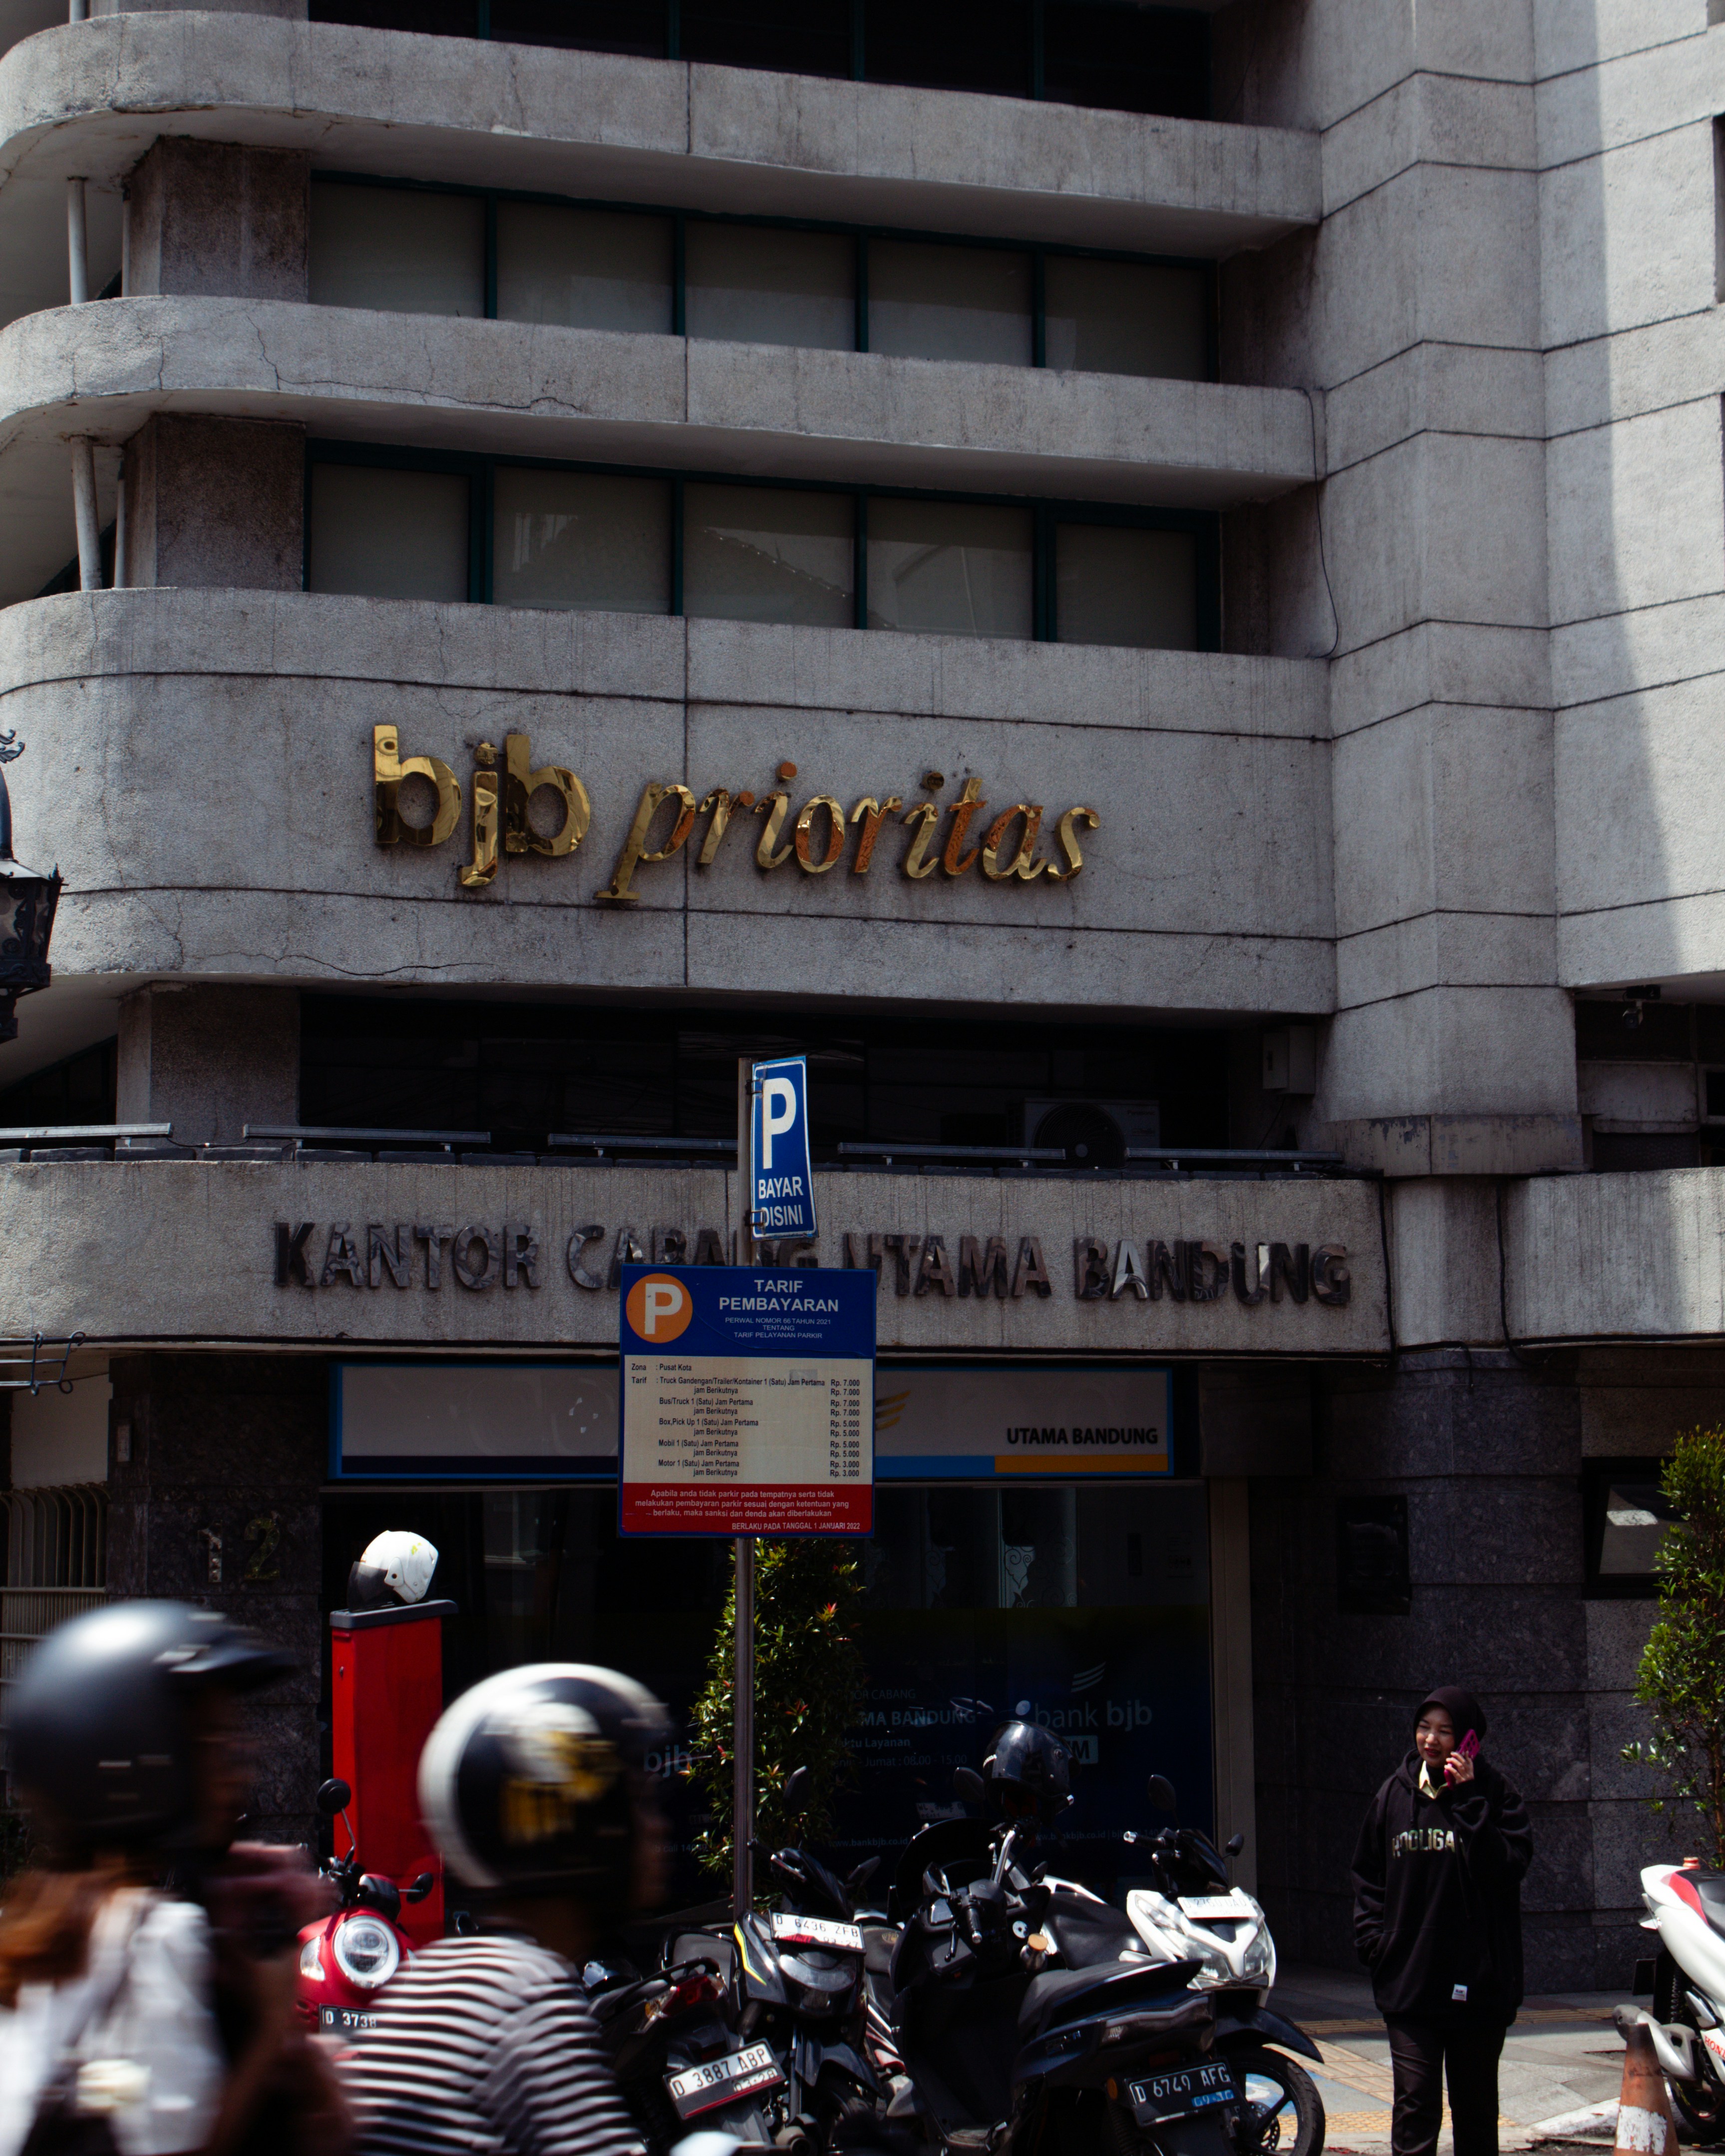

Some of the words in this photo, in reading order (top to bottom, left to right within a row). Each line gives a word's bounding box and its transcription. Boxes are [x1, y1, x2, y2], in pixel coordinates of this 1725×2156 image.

[373, 724, 591, 887] bjb
[595, 761, 1100, 899] prioritas
[763, 1077, 796, 1169] P
[758, 1176, 803, 1199] BAYAR
[761, 1205, 803, 1227] DISINI
[275, 1222, 541, 1289] KANTOR
[843, 1232, 1051, 1297] UTAMA
[1074, 1237, 1349, 1305] BANDUNG
[754, 1279, 803, 1293] TARIF
[645, 1283, 683, 1335] P
[719, 1297, 838, 1312] PEMBAYARAN
[679, 1377, 762, 1385] Gandengan/Trailer/Kontainer
[769, 1378, 786, 1386] (Satu)
[831, 1388, 841, 1397] Rp.
[696, 1398, 713, 1406] (Satu)
[693, 1407, 704, 1415] jam
[706, 1407, 737, 1416] Berikutnya
[687, 1418, 695, 1427] Up
[701, 1418, 719, 1427] (Satu)
[706, 1428, 737, 1437] Berikutnya
[1007, 1428, 1068, 1445] UTAMA
[1073, 1428, 1158, 1445] BANDUNG
[682, 1439, 699, 1448] (Satu)
[682, 1459, 699, 1468] (Satu)
[706, 1469, 737, 1477] Berikutnya
[651, 1490, 678, 1498] Apabila
[718, 1490, 739, 1499] parkir
[760, 1491, 796, 1499] tempatnya
[676, 1500, 719, 1508] pembayaran
[872, 1689, 916, 1700] CABANG
[891, 1710, 977, 1726] BANDUNG
[1035, 1701, 1098, 1728] bank
[1106, 1699, 1153, 1732] bjb
[865, 1738, 911, 1749] Layanan
[866, 1756, 896, 1767] Jumat
[904, 1755, 931, 1766] 08.00
[941, 1754, 967, 1765] 15.00
[776, 1915, 783, 1924] D
[795, 1918, 826, 1931] 6436
[834, 1925, 858, 1937] ZFB
[326, 2010, 334, 2024] D
[673, 2080, 685, 2096] D
[692, 2060, 731, 2087] 3887
[737, 2048, 765, 2071] ABP
[1134, 2085, 1146, 2103] D
[1200, 2066, 1231, 2087] AFG
